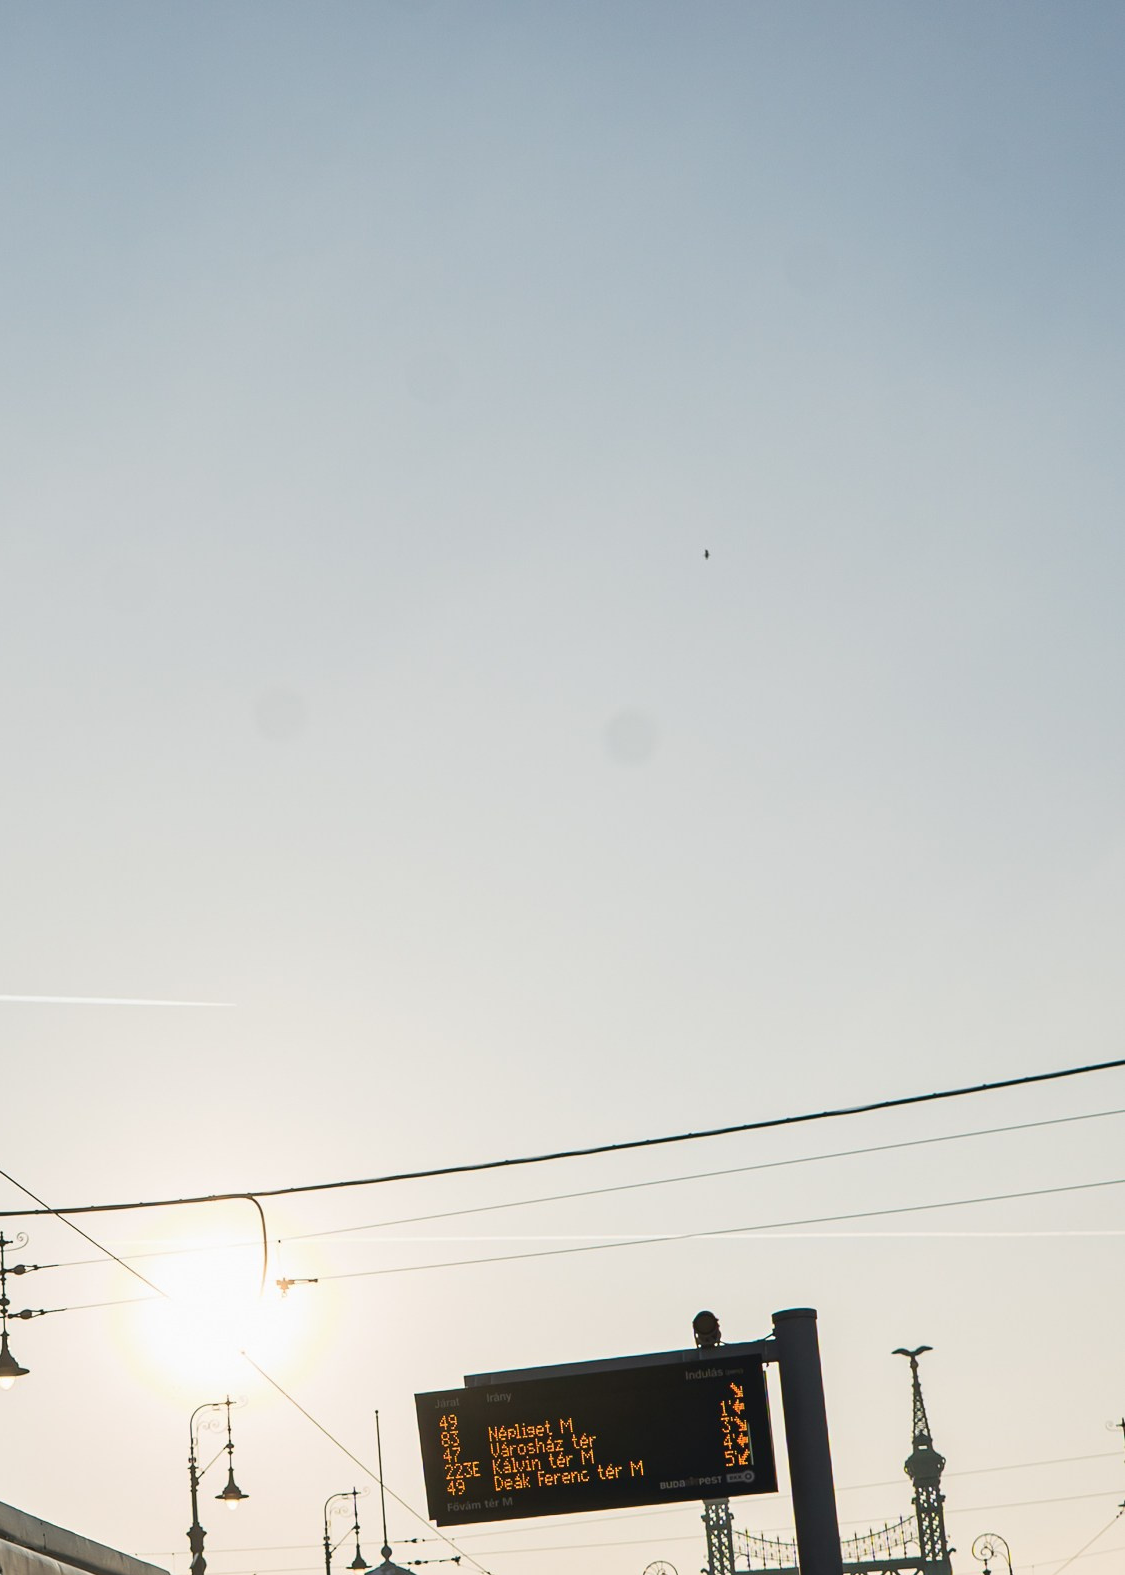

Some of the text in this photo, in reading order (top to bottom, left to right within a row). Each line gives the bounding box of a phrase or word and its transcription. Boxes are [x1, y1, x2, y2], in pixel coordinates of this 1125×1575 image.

[685, 1367, 724, 1381] Indulás
[435, 1398, 460, 1409] Járat
[486, 1392, 513, 1403] Irány
[439, 1414, 458, 1430] 49
[488, 1417, 574, 1442] Népliget M
[440, 1430, 460, 1447] 83
[490, 1433, 597, 1458] Városház tér
[443, 1446, 461, 1463] 47
[492, 1448, 595, 1475] Kálvin tér M
[444, 1461, 482, 1480] 223E
[493, 1459, 644, 1492] Deák Ferenc tér M
[447, 1479, 466, 1496] 49
[447, 1496, 514, 1512] Fővám tér M
